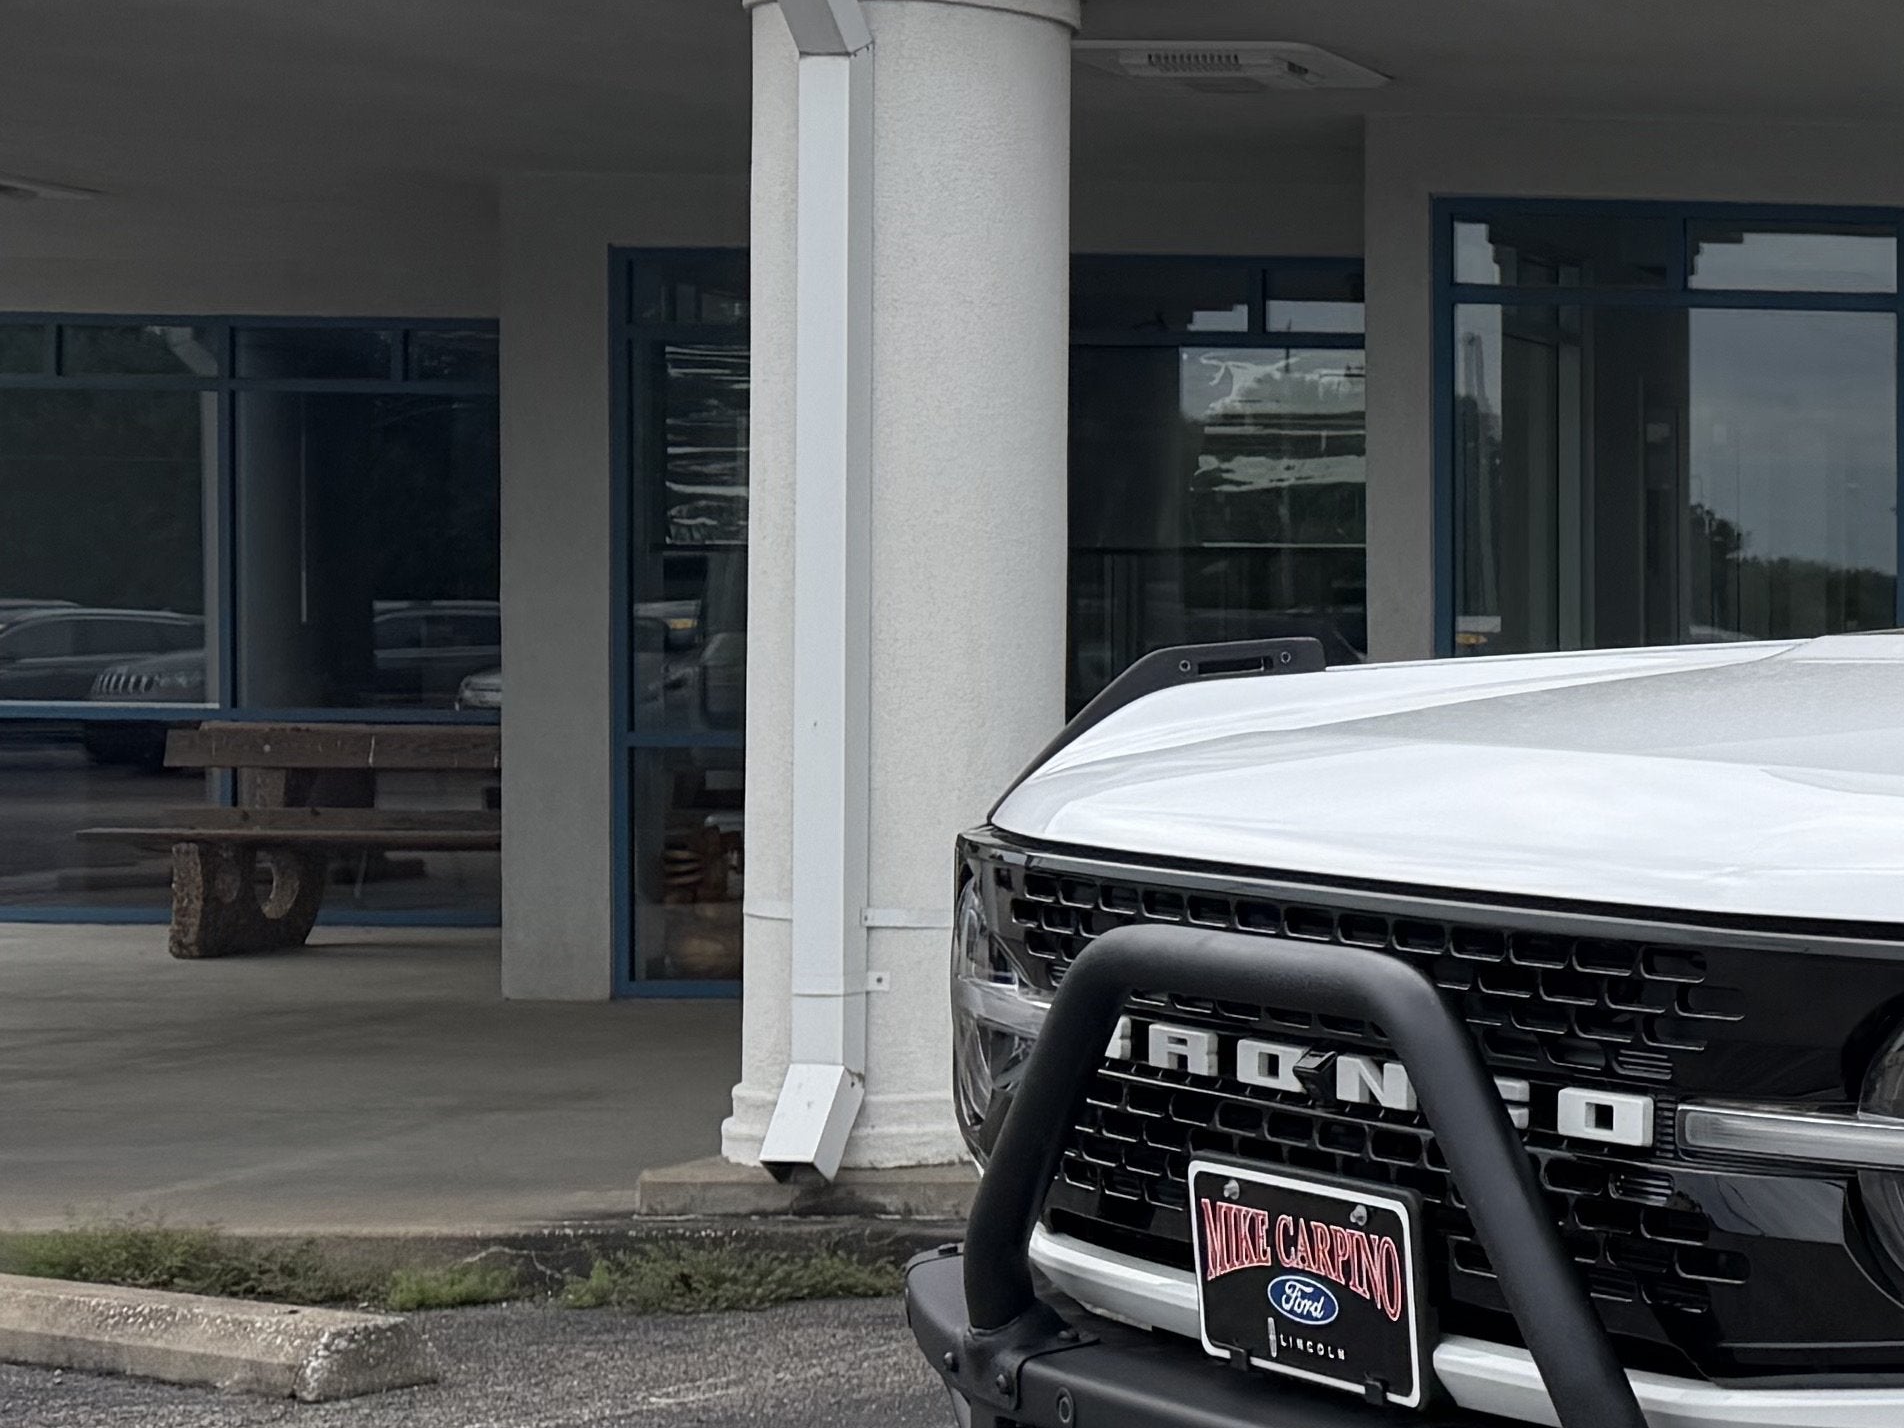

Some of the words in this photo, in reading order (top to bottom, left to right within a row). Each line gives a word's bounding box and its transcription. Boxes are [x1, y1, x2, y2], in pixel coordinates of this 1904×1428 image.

[1105, 1015, 1654, 1147] RONO
[1200, 1198, 1272, 1281] MIKE
[1275, 1214, 1401, 1322] CARPINO
[1280, 1279, 1325, 1320] Ford
[1280, 1333, 1345, 1361] LINCOLN
